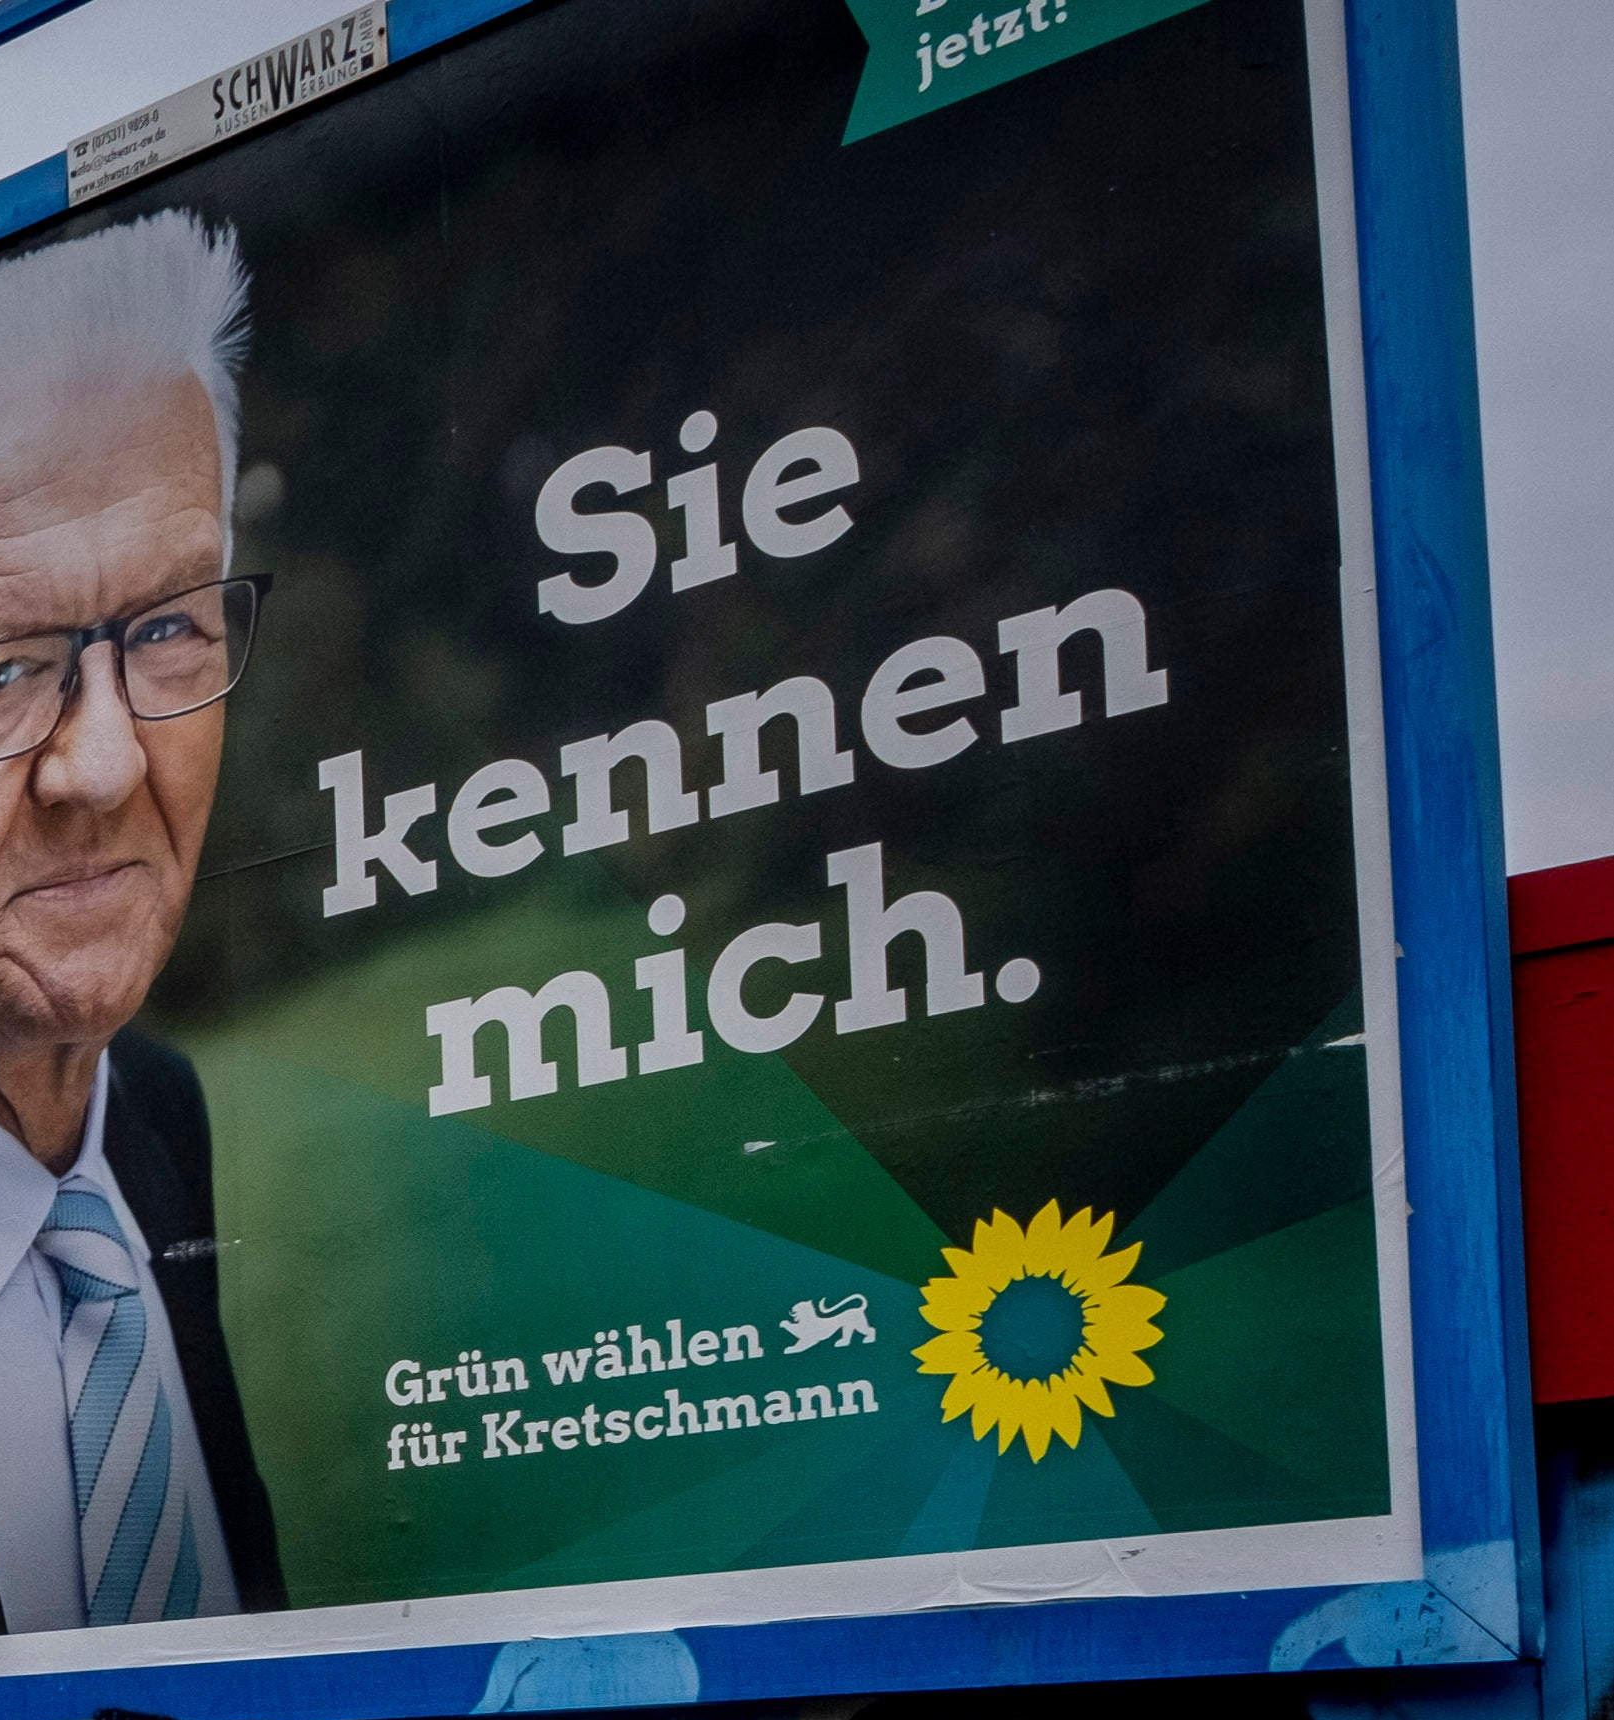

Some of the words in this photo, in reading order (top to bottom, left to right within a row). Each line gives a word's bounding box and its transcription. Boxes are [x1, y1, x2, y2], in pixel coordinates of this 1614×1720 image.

[212, 16, 357, 120] SCHWARZ
[916, 0, 1067, 93] jetzt!
[535, 410, 860, 625] Sie
[317, 584, 1168, 920] kennen
[424, 838, 1041, 1117] mich.
[384, 1344, 529, 1408] Grün
[540, 1319, 764, 1391] wählen
[385, 1418, 473, 1472] für
[481, 1368, 878, 1459] Kretschmann
